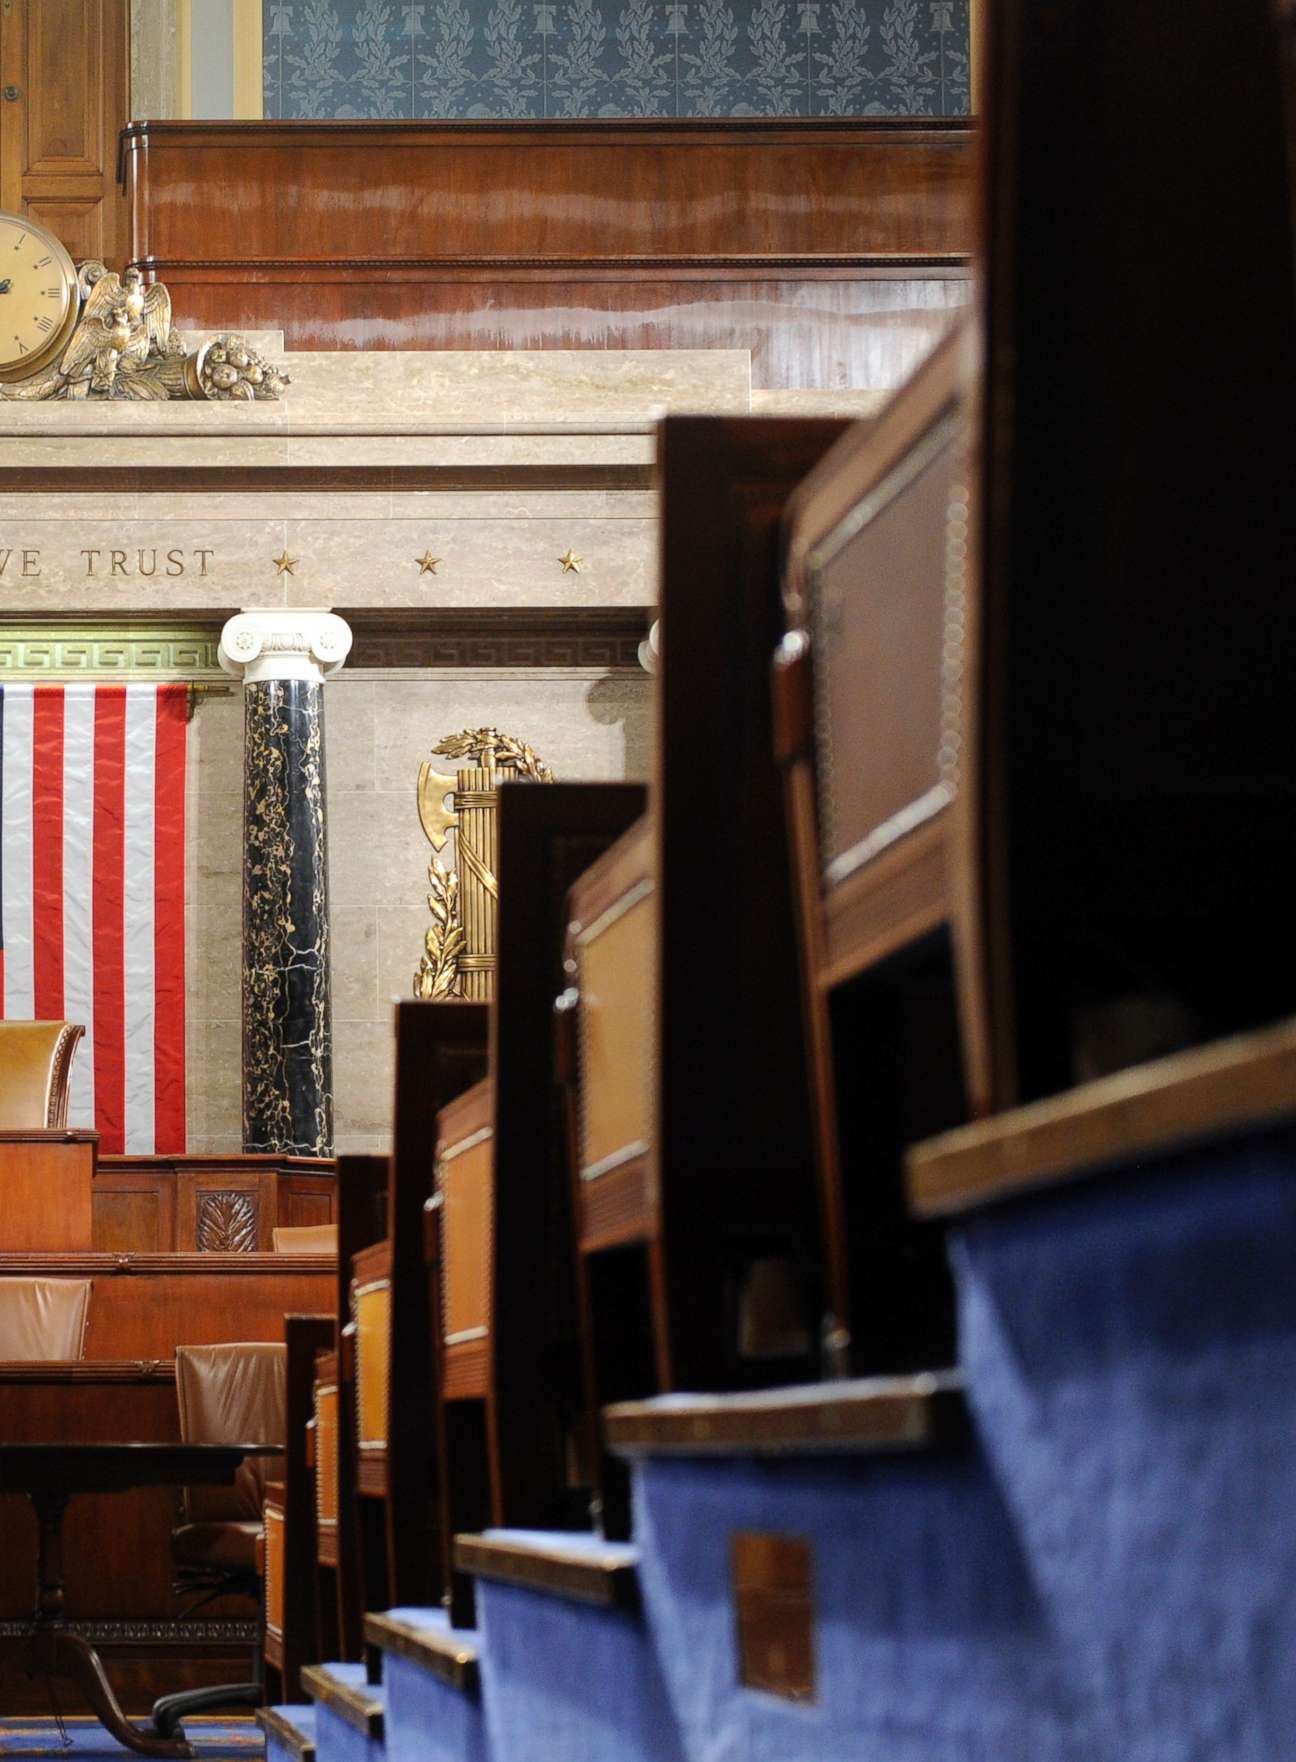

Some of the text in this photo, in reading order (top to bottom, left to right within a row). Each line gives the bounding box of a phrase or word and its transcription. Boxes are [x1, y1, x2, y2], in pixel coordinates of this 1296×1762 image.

[39, 257, 52, 267] II
[48, 288, 60, 298] III
[38, 316, 53, 332] IIII
[19, 343, 28, 354] V
[80, 549, 215, 577] TRUST
